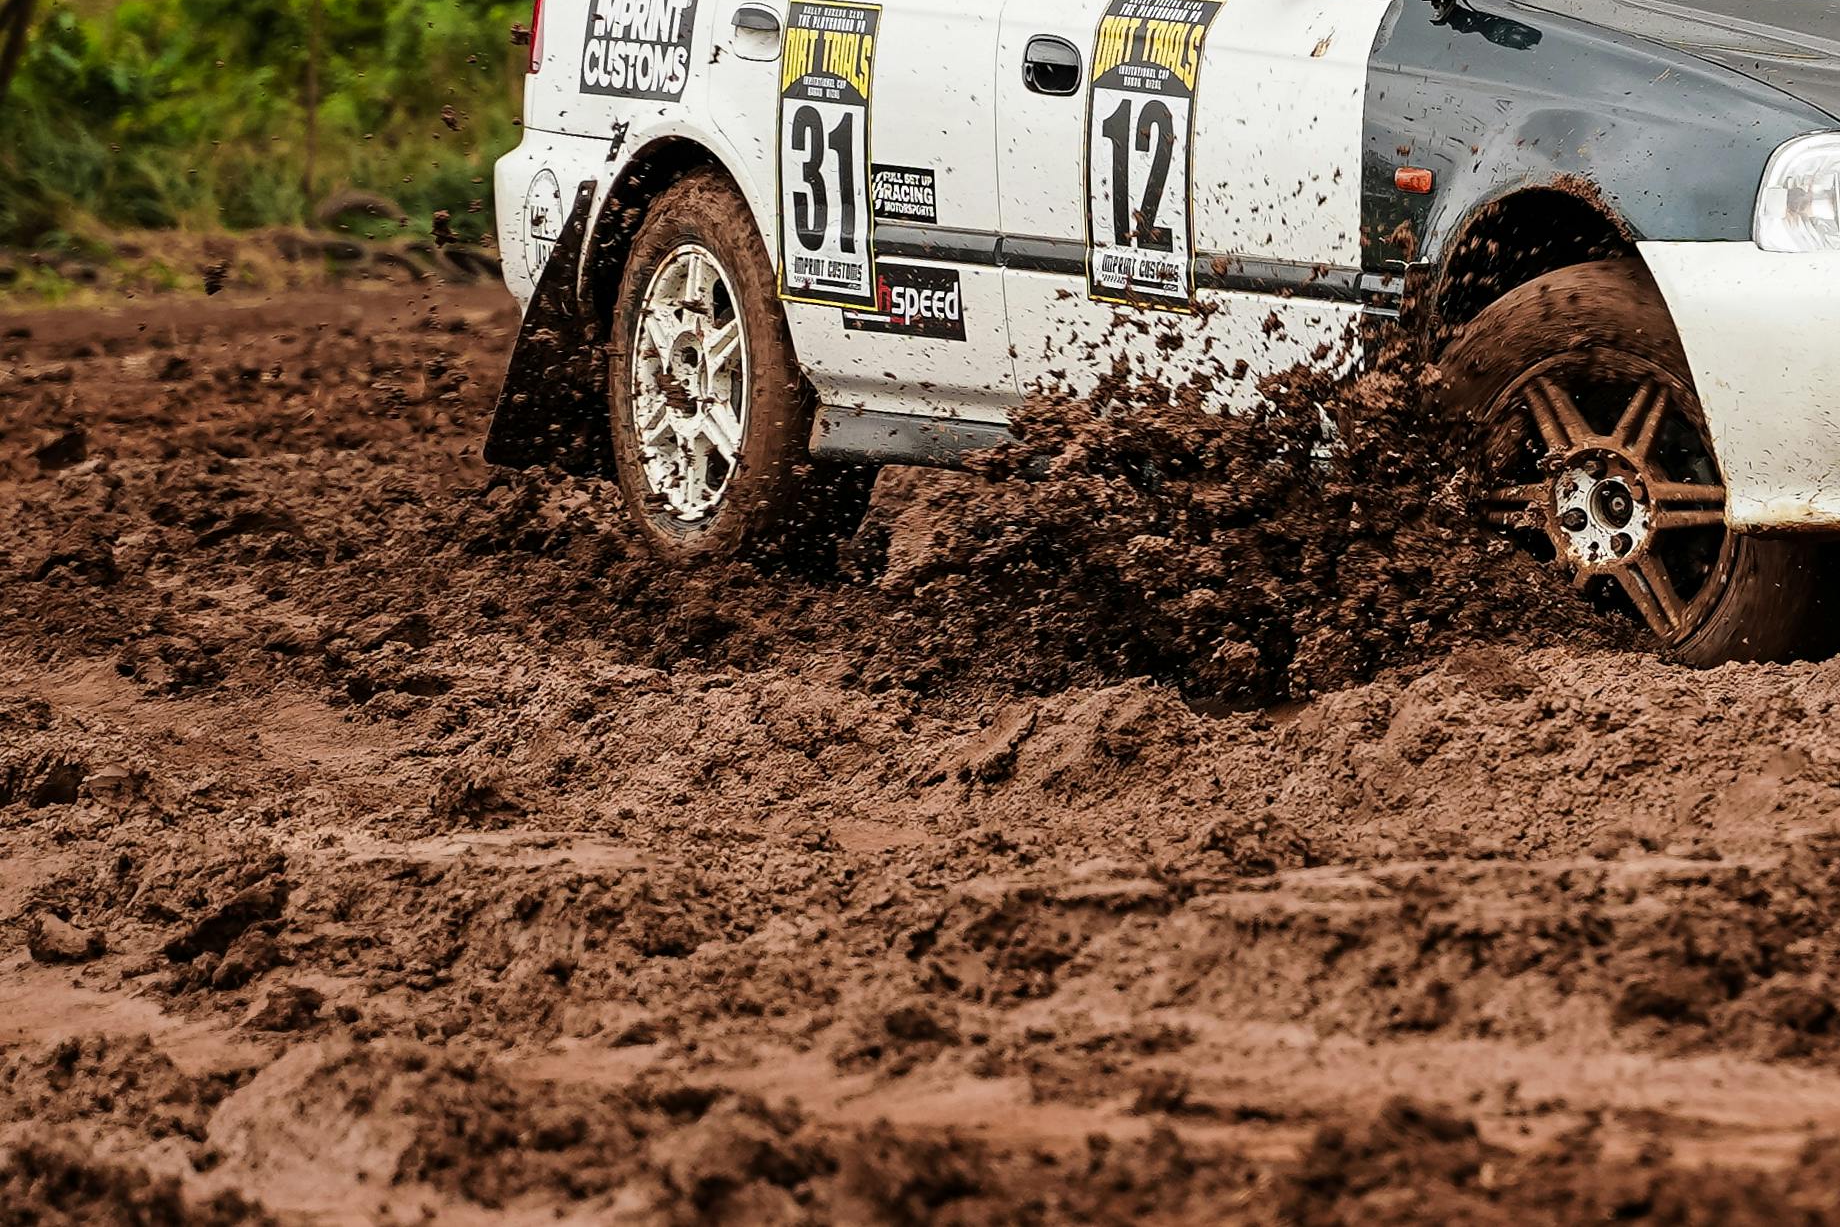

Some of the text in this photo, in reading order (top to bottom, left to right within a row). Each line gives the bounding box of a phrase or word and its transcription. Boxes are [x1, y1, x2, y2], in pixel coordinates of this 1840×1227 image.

[583, 38, 689, 95] CUSTOMS
[782, 27, 873, 99] DIRT TRIALS
[1092, 15, 1206, 92] DIRT TRIALS
[791, 105, 856, 254] 31
[883, 183, 934, 205] RACING
[1102, 99, 1174, 253] 12
